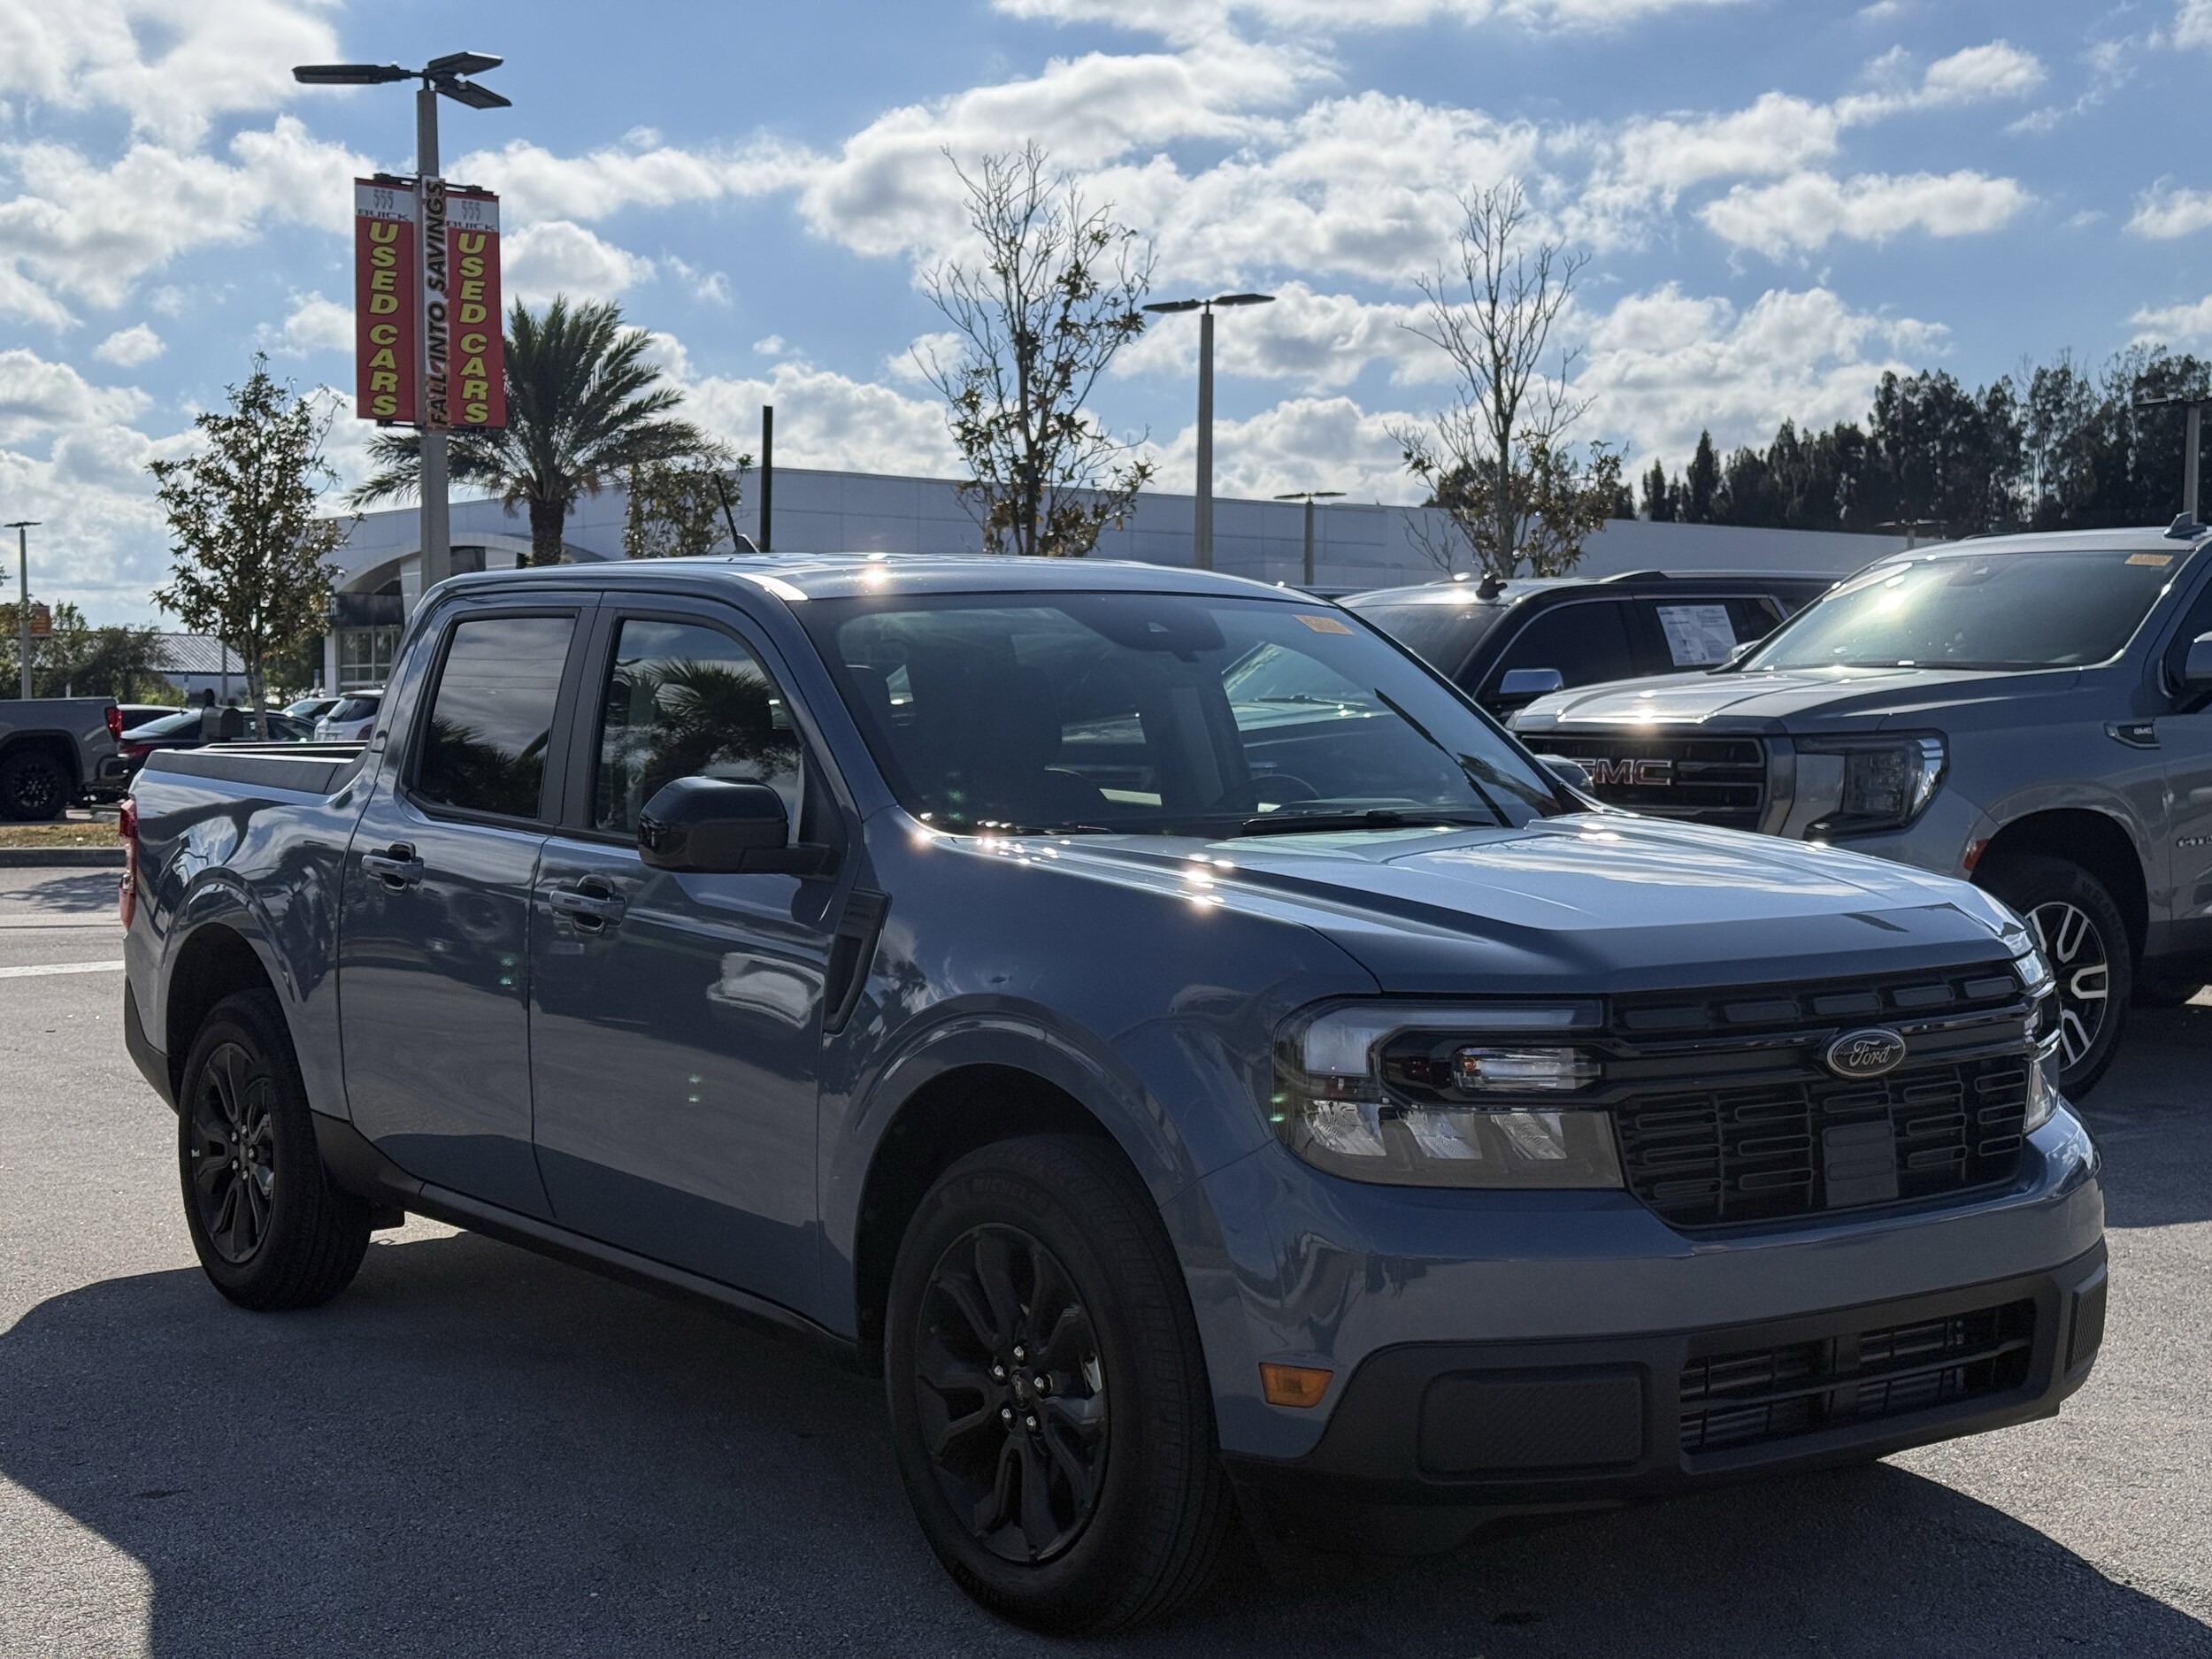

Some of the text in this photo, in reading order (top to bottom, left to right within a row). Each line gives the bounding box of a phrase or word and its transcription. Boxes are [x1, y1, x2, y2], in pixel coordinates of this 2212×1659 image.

[357, 209, 410, 221] BUICK
[426, 180, 449, 426] FALL INTO SAVINGS
[368, 221, 399, 417] USED CARS
[457, 233, 488, 424] USED CARS
[1849, 1040, 1891, 1067] Ford
